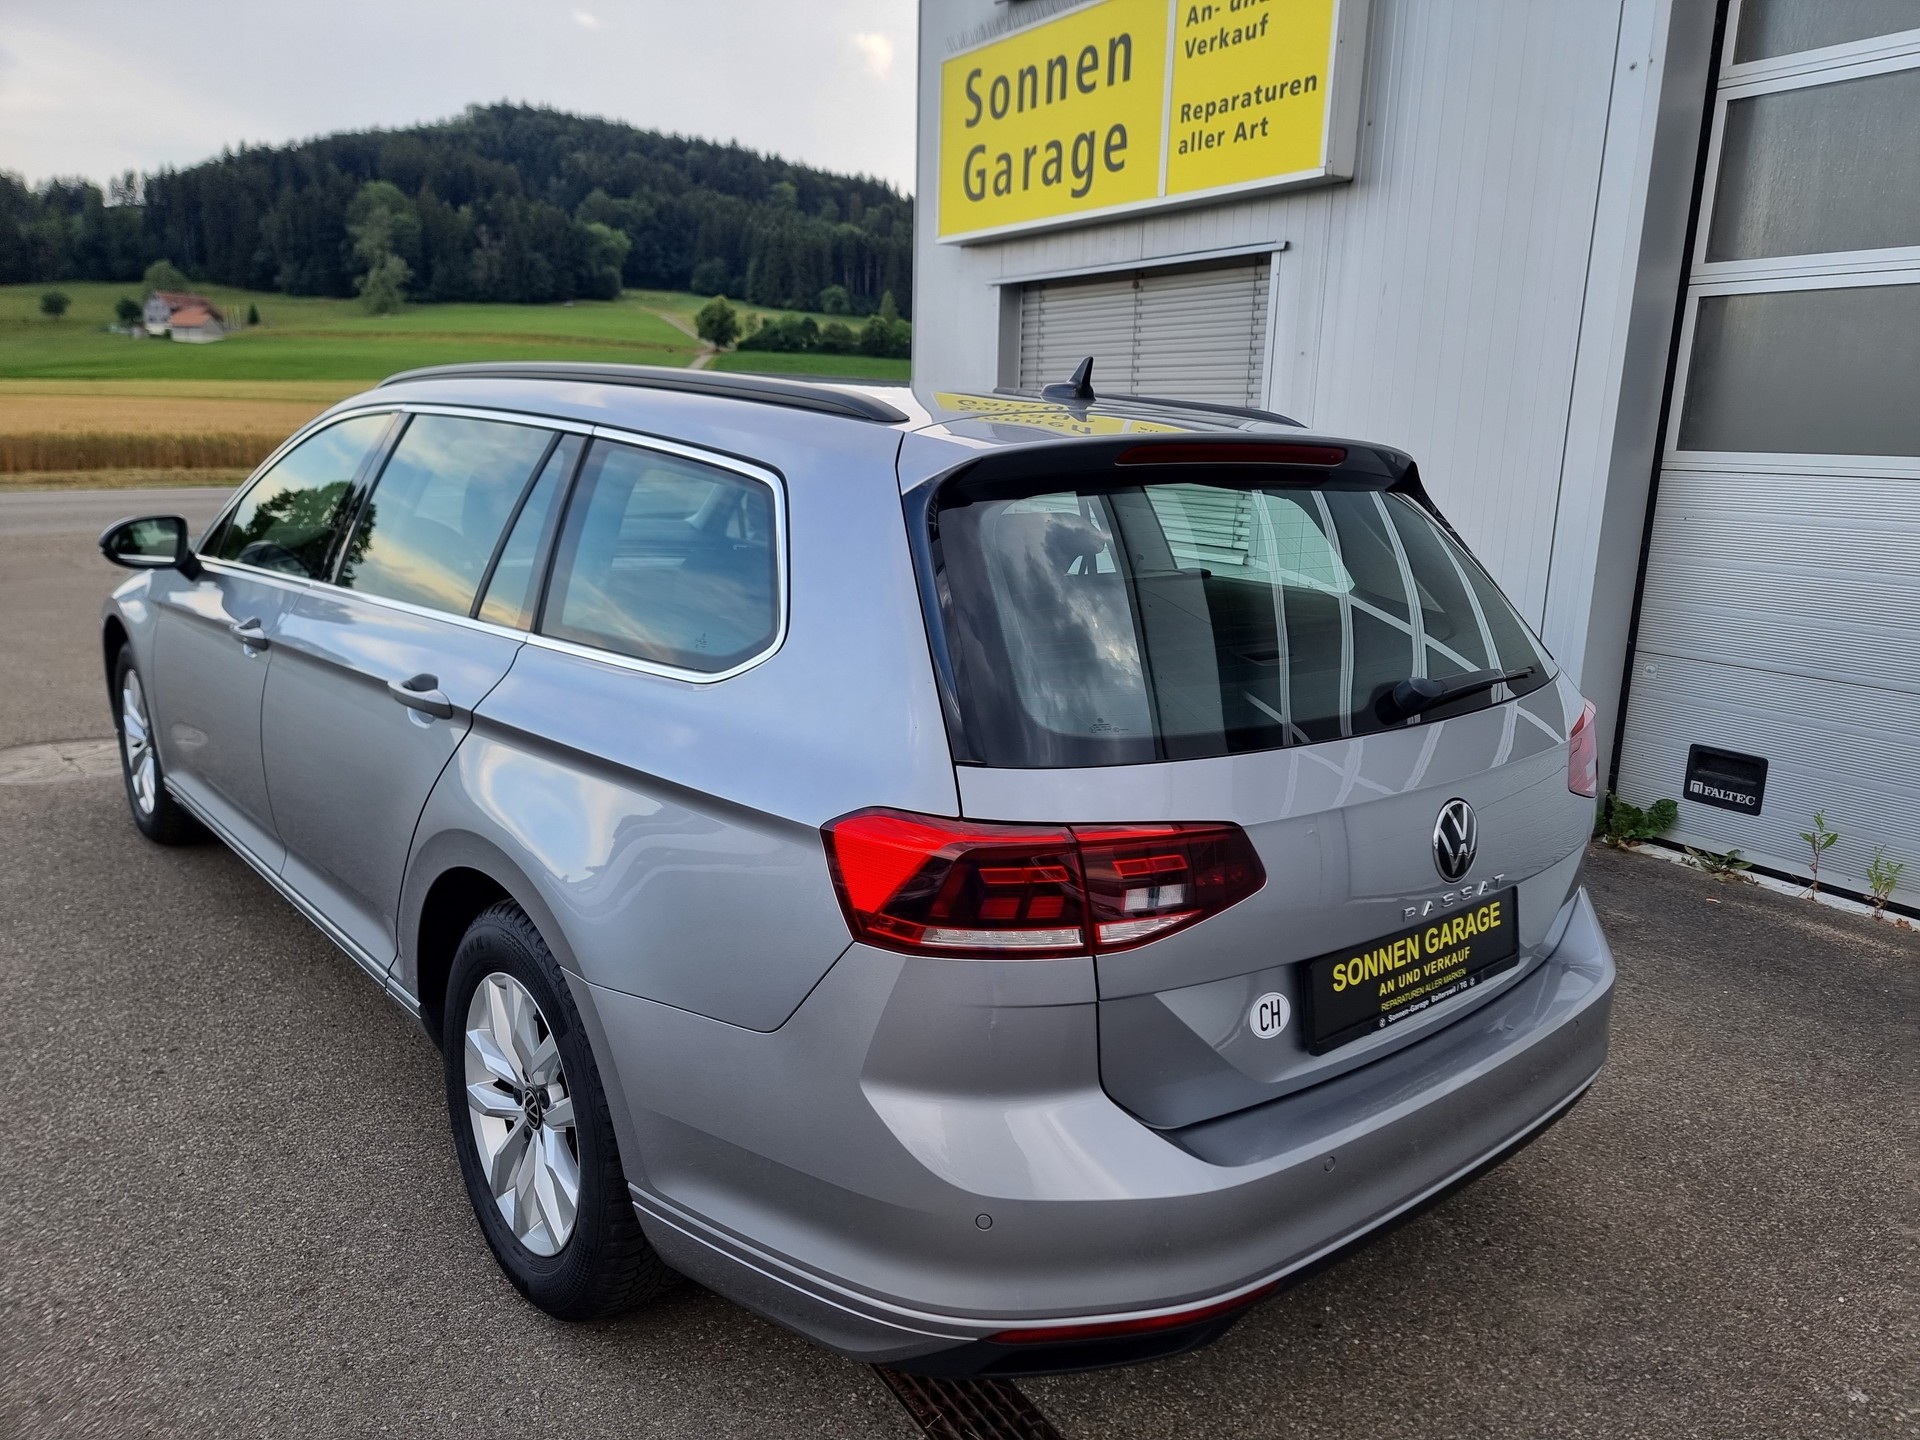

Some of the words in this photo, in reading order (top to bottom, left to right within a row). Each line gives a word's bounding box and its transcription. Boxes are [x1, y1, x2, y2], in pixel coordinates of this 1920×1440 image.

[1184, 13, 1269, 59] Verkauf
[1185, 5, 1221, 27] An-
[964, 32, 1132, 129] Sonnen
[1180, 74, 1317, 124] Reparaturen
[1178, 130, 1226, 155] aller
[1233, 117, 1269, 143] Art
[963, 121, 1128, 202] Garage
[1703, 786, 1756, 806] FALTEC
[1402, 873, 1505, 923] PASSAT
[1332, 934, 1420, 992] SONNEN
[1425, 901, 1501, 953] GARAGE
[1379, 979, 1395, 997] AN
[1399, 968, 1421, 988] UND
[1423, 946, 1471, 976] VERKAUF
[1259, 998, 1281, 1031] CH
